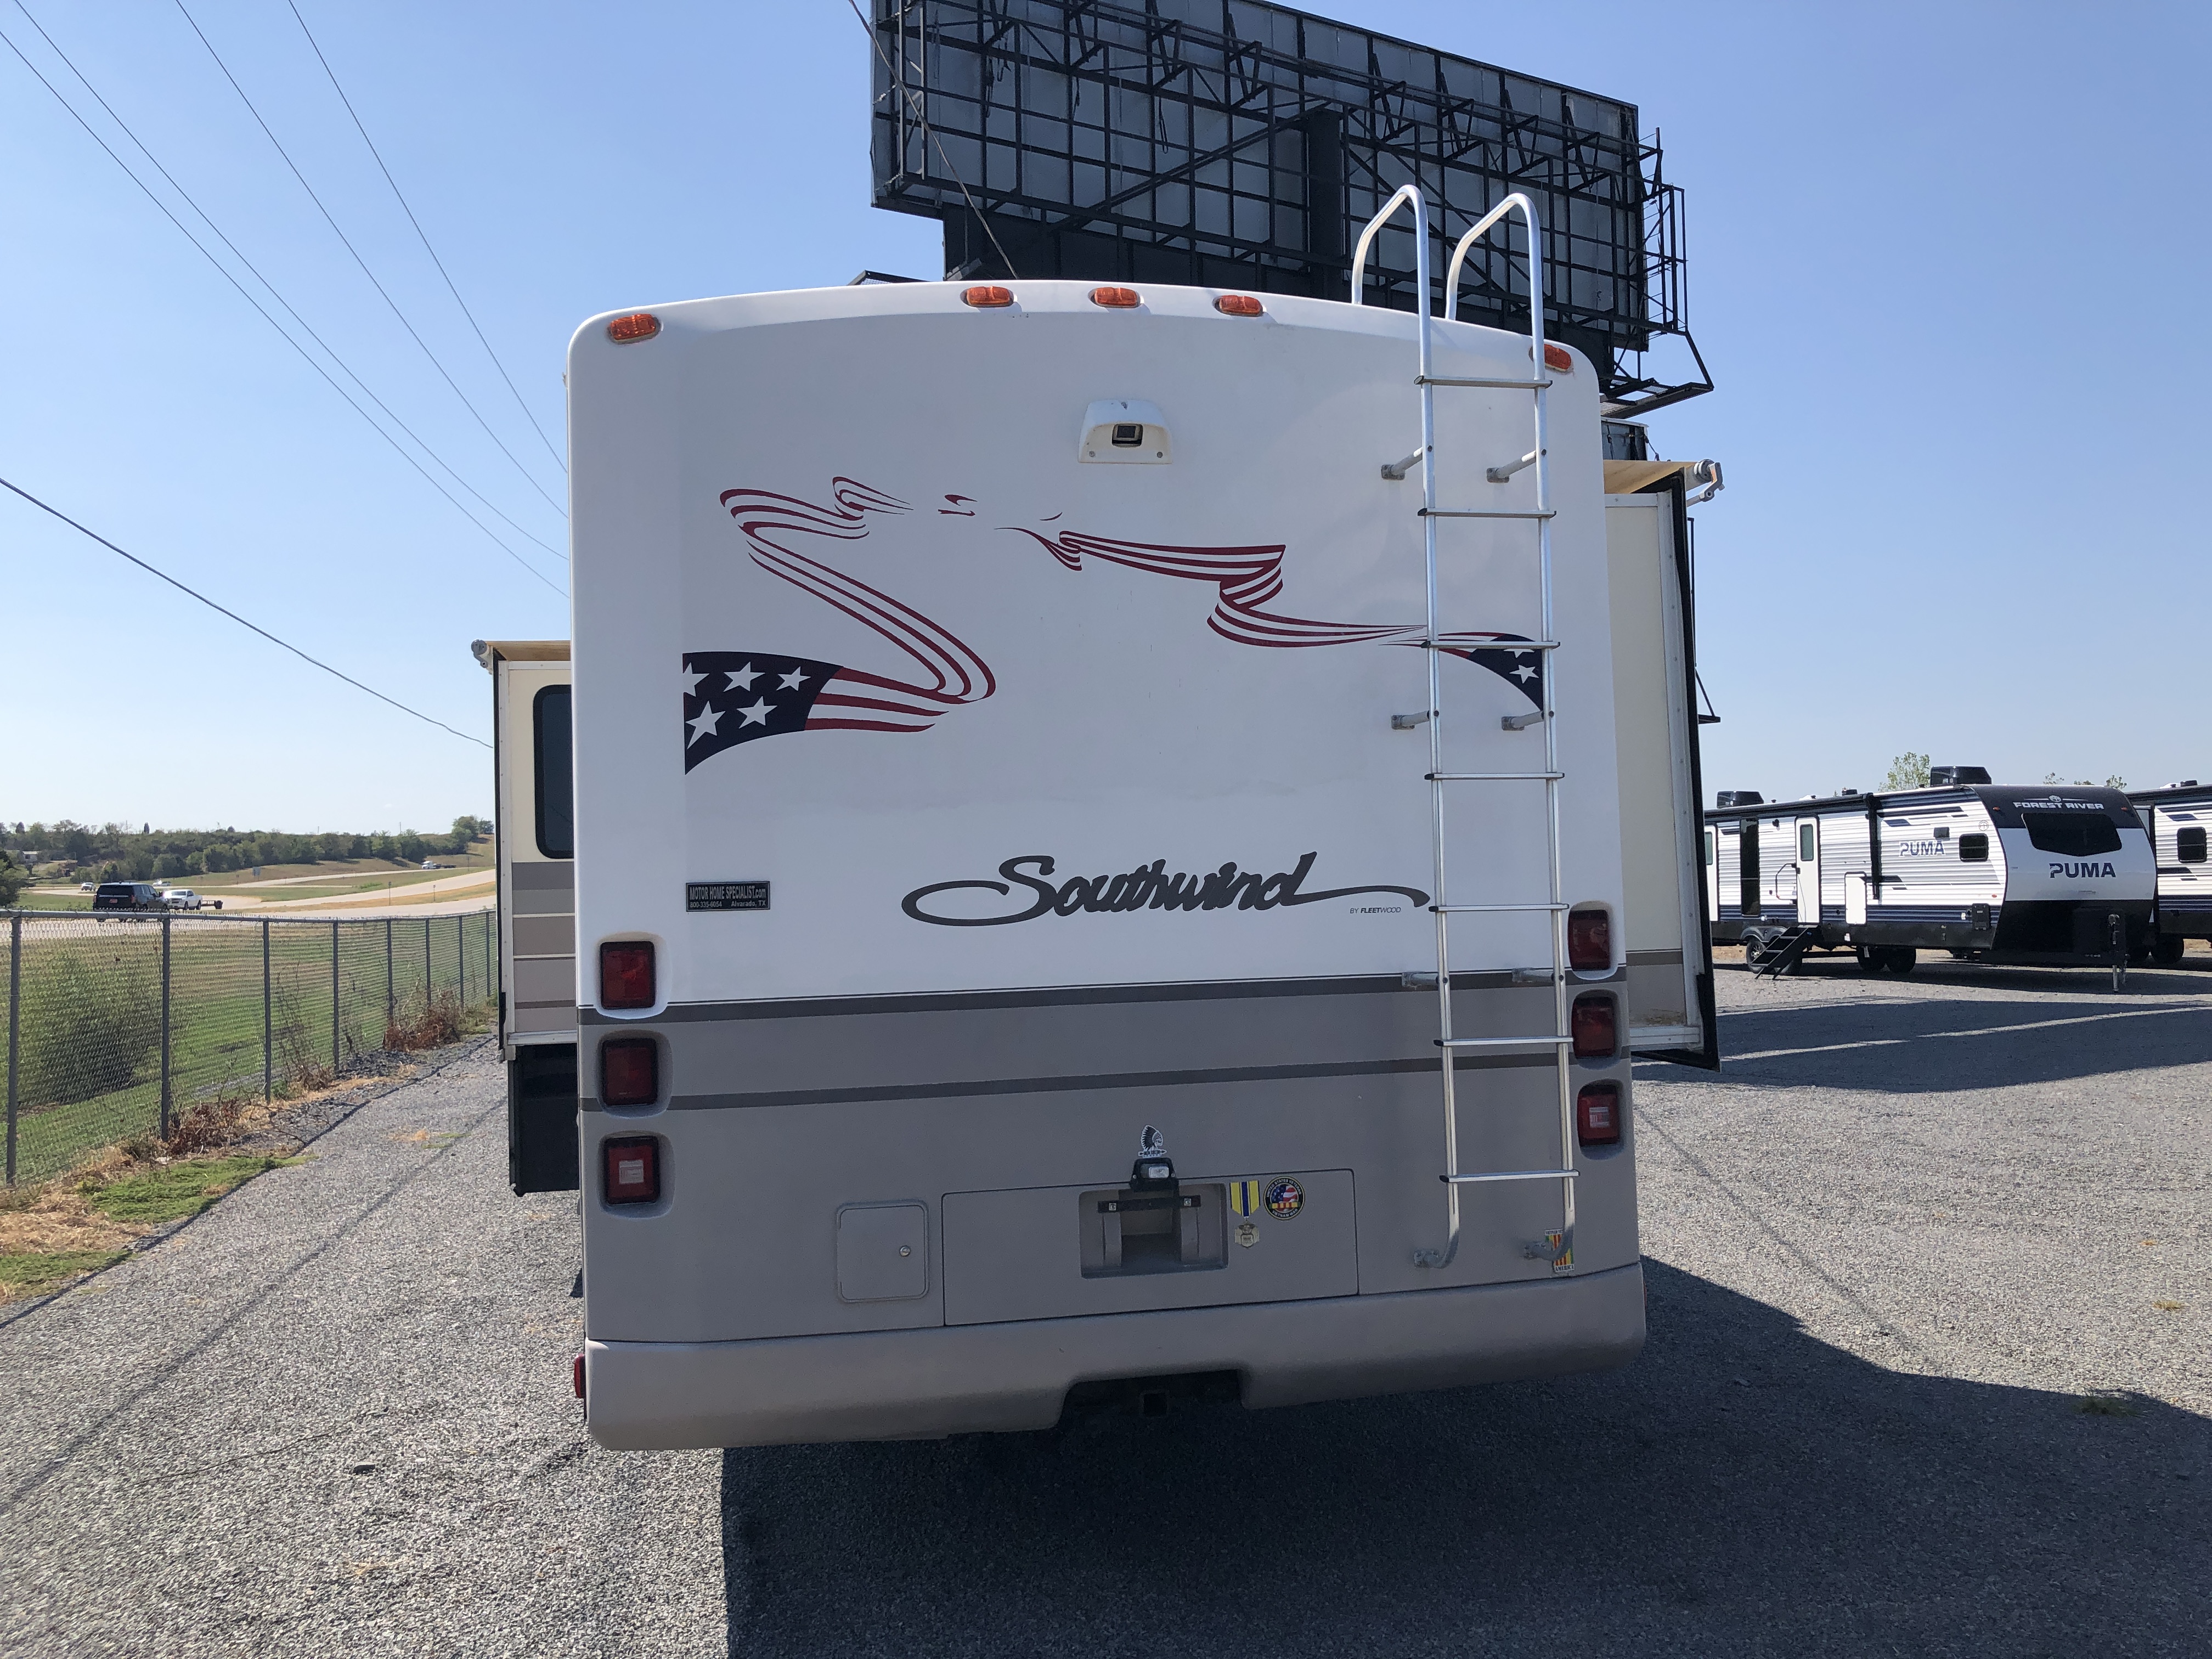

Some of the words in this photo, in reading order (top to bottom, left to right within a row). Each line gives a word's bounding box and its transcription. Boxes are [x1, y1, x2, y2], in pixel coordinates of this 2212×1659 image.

[1899, 839, 1945, 856] PUMA
[2049, 862, 2116, 878] PUMA
[690, 887, 708, 900] MOTOR
[709, 886, 724, 899] HOME
[726, 885, 766, 899] SPECIALIST.com
[901, 851, 1430, 926] Southwind
[1266, 1183, 1275, 1198] UNITED
